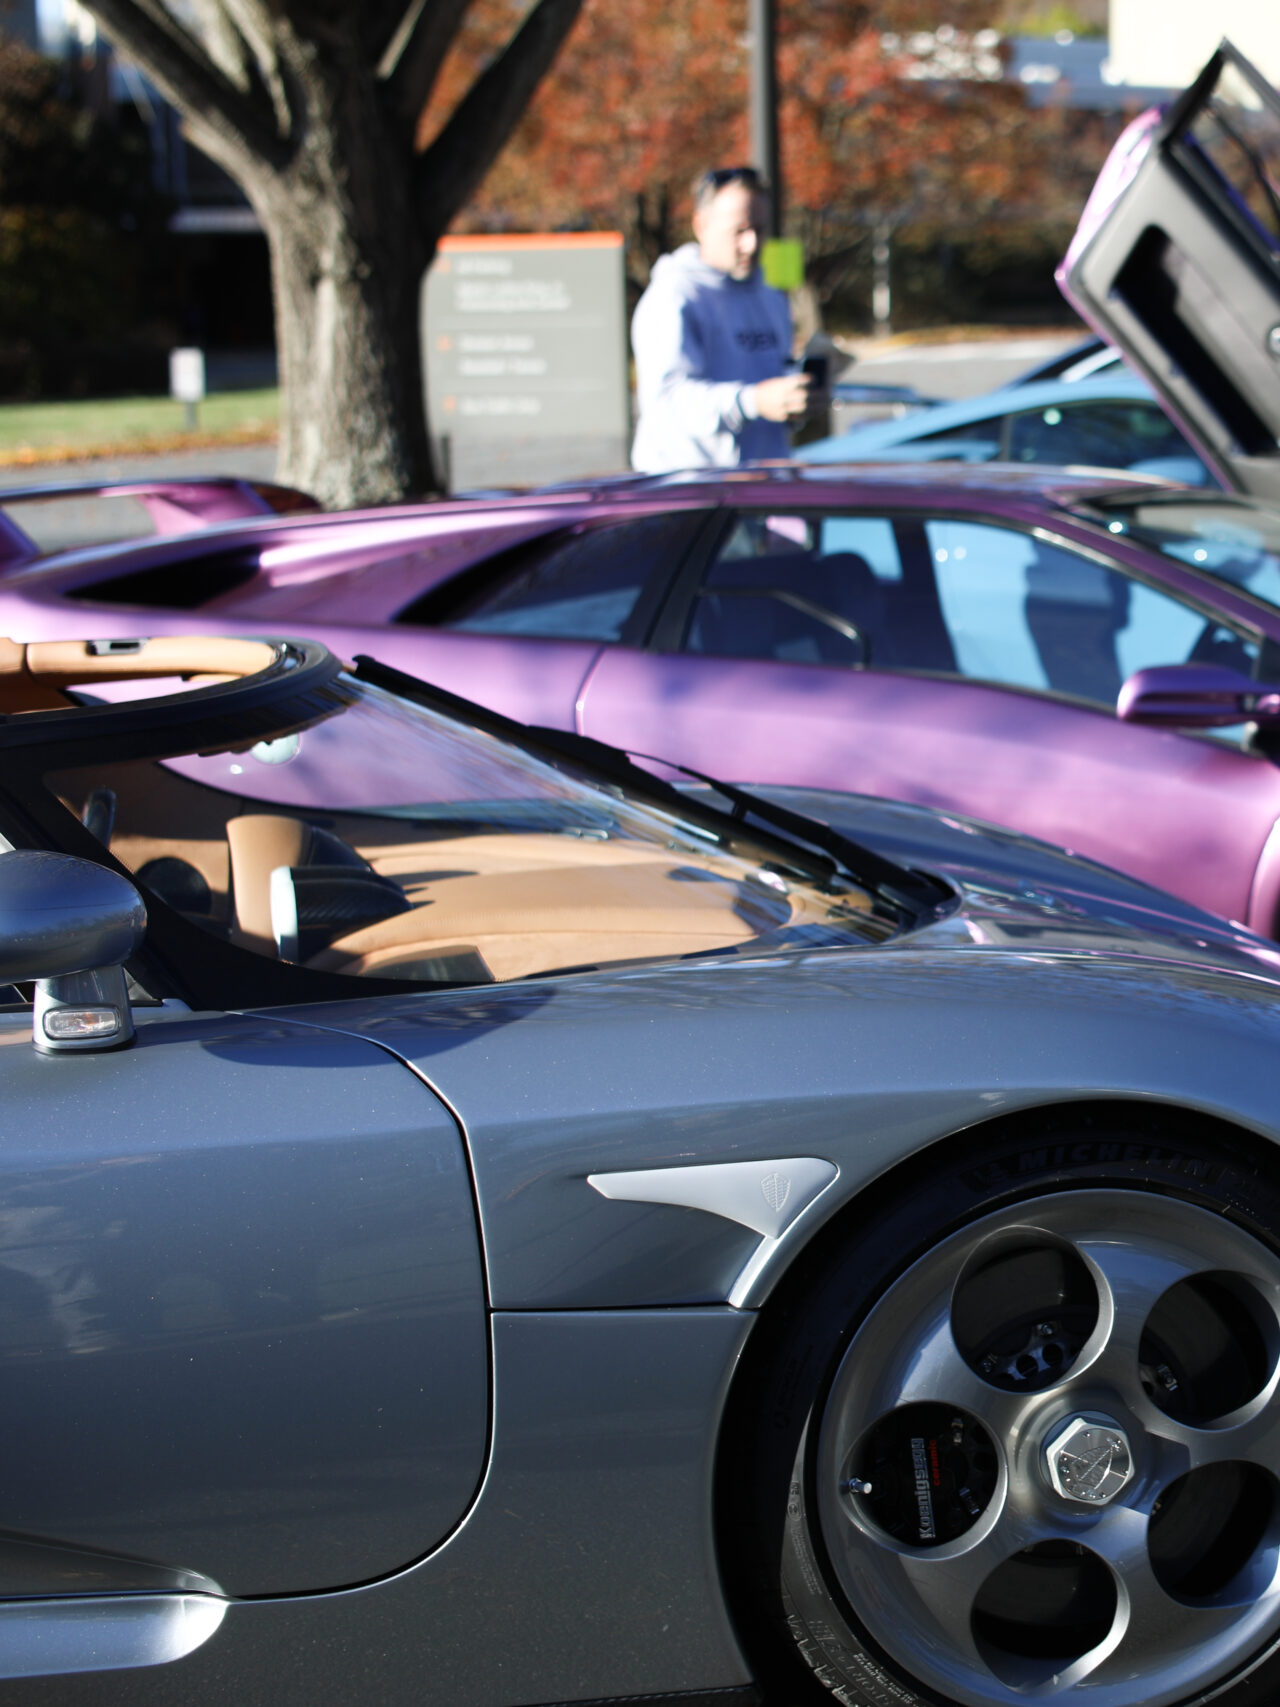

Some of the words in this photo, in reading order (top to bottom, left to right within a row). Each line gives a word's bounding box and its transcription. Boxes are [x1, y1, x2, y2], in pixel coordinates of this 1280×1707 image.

[1017, 1143, 1213, 1179] MICHELIN
[928, 1440, 941, 1486] ceramic
[910, 1437, 936, 1540] Koenigsegg
